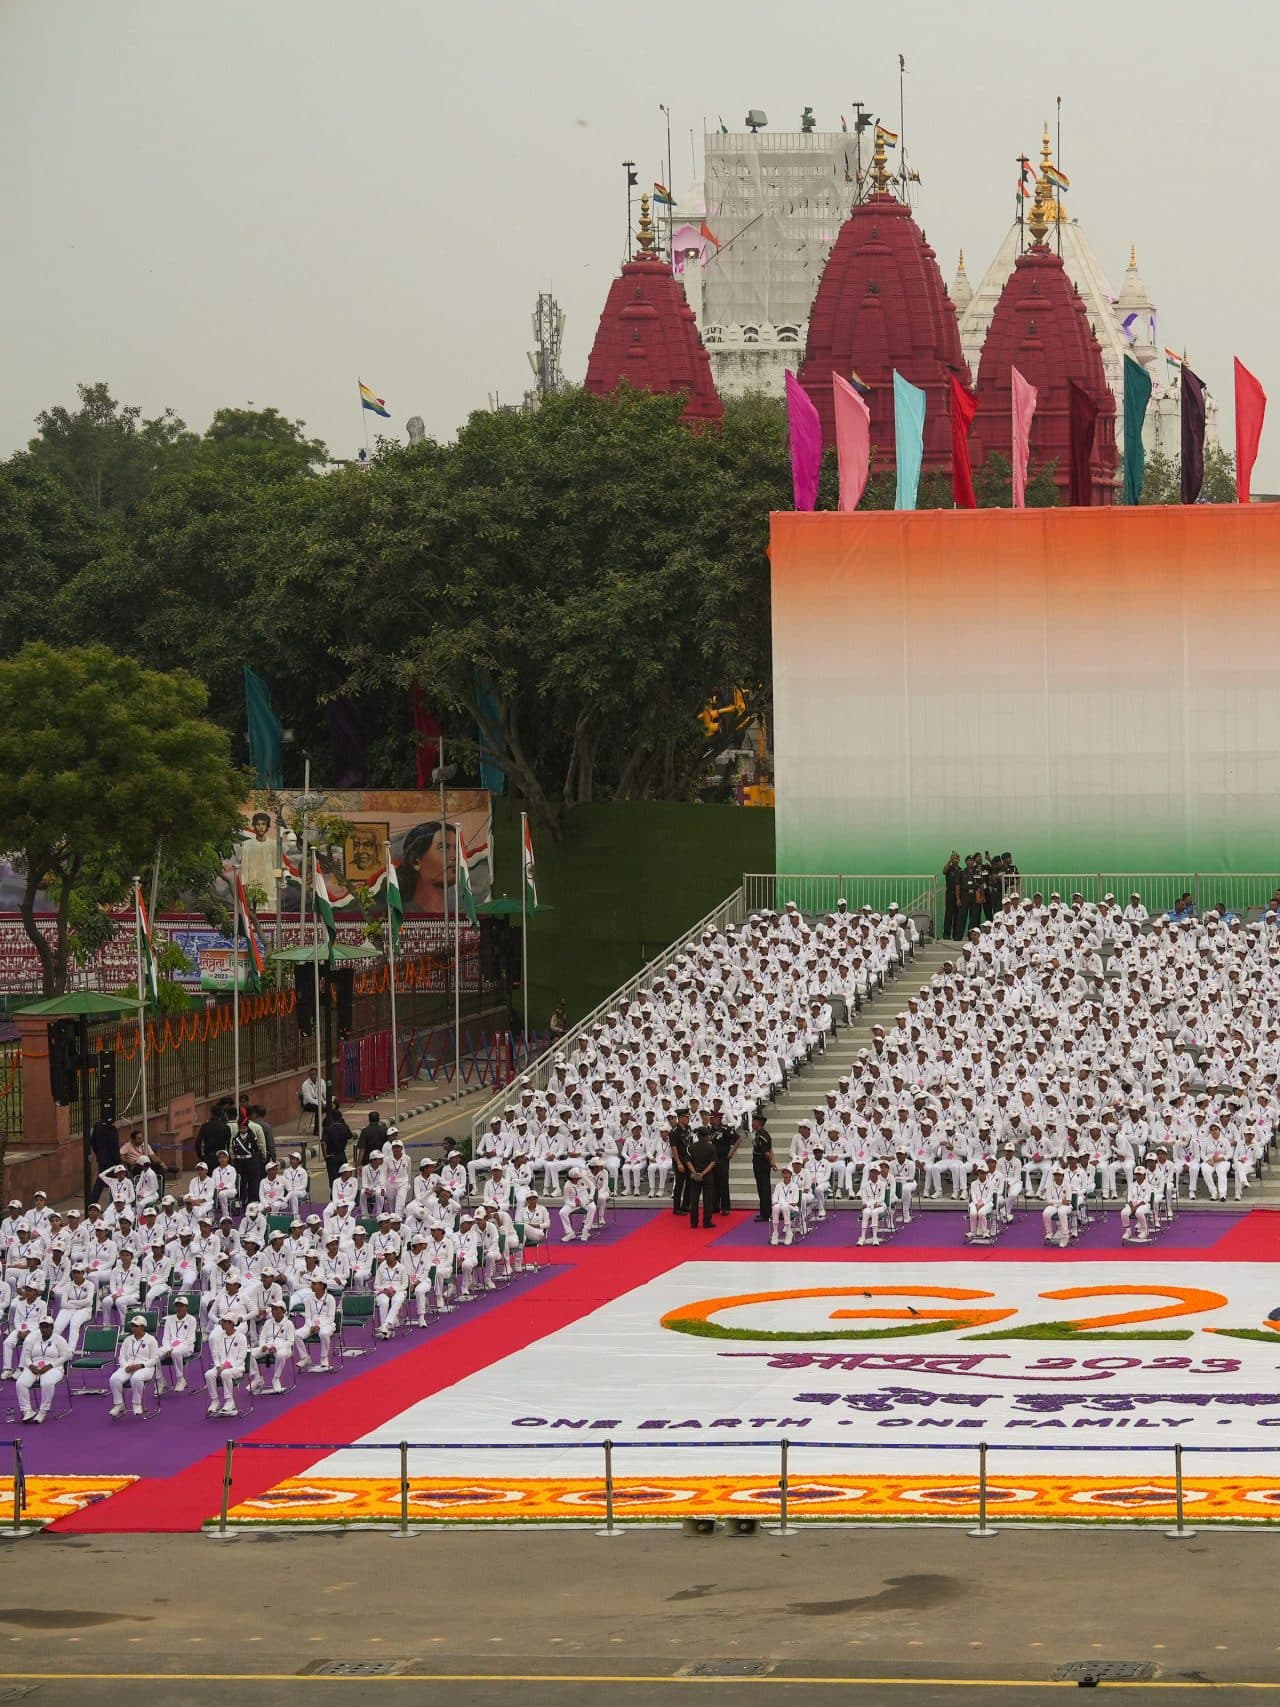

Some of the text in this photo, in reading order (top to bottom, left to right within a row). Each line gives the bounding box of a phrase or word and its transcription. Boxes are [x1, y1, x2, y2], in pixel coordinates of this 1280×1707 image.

[1025, 1357, 1242, 1373] 2023
[511, 1417, 622, 1429] ONE
[637, 1417, 812, 1429] EARTH
[877, 1418, 988, 1428] ONE
[1005, 1418, 1194, 1428] FAMILY
